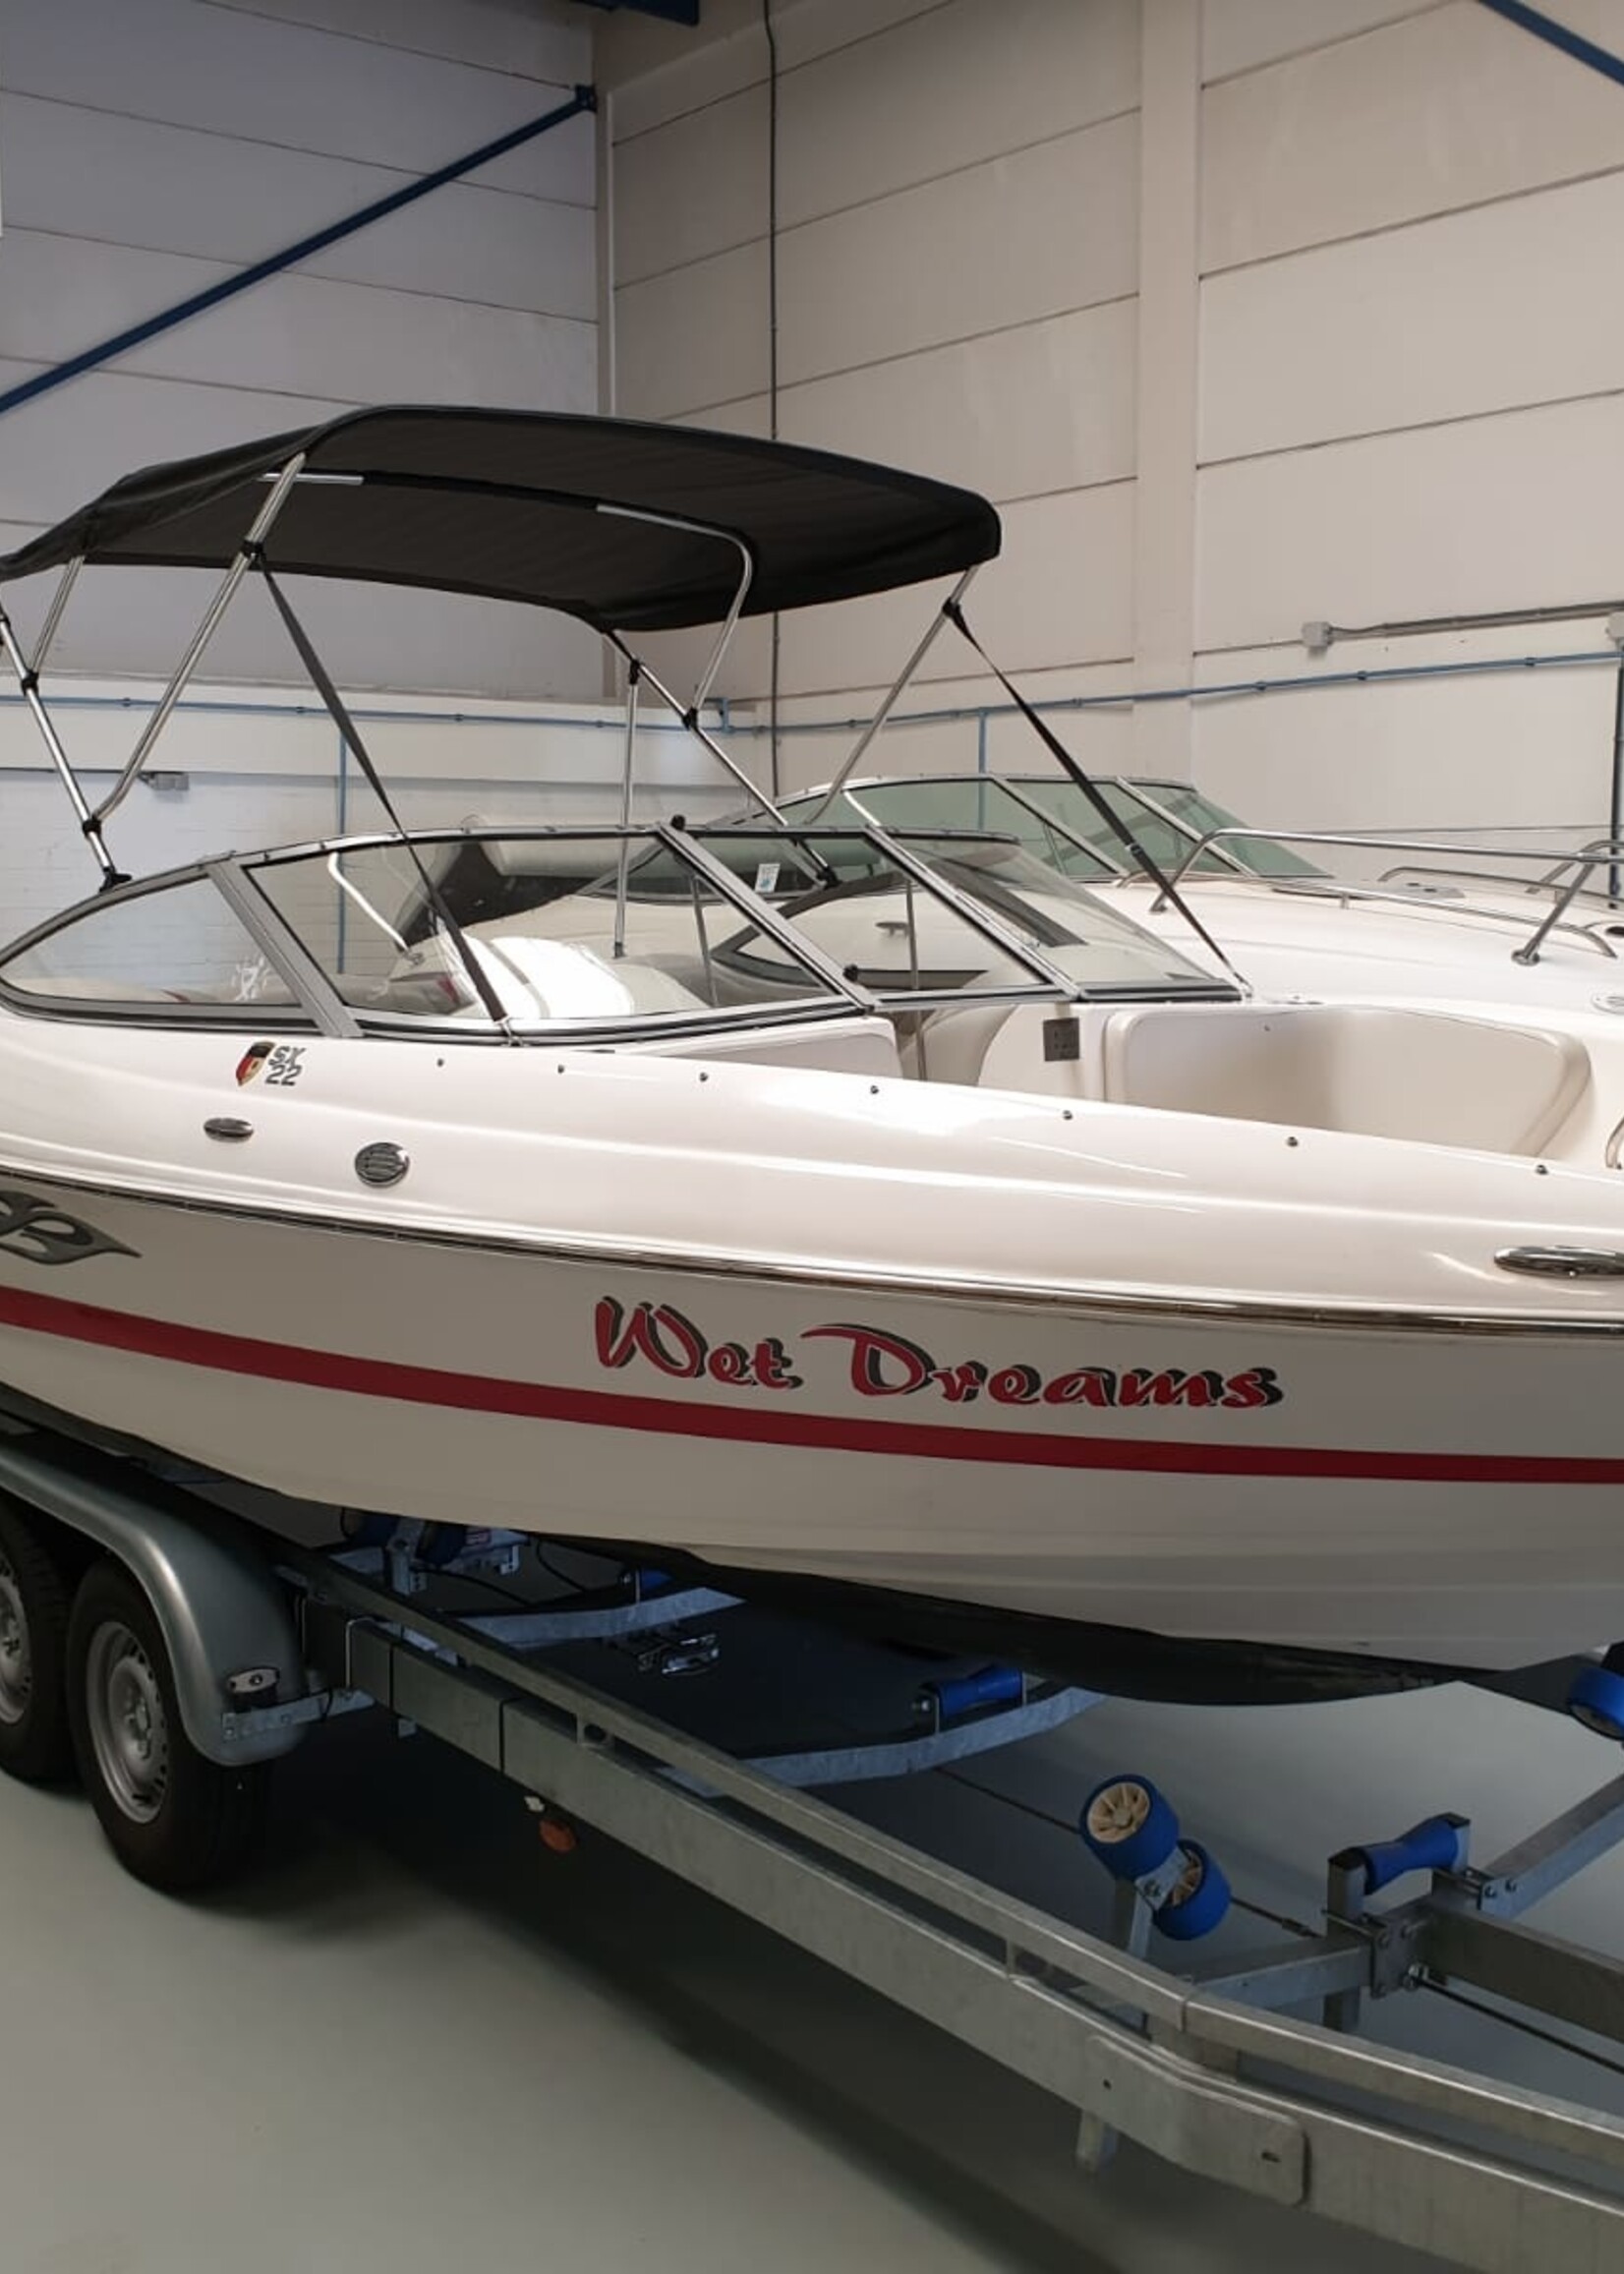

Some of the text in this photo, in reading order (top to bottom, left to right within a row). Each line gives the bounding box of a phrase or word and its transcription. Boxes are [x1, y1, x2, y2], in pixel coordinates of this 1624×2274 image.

[264, 1064, 303, 1086] 22
[595, 1296, 1284, 1408] Wet Dreams
